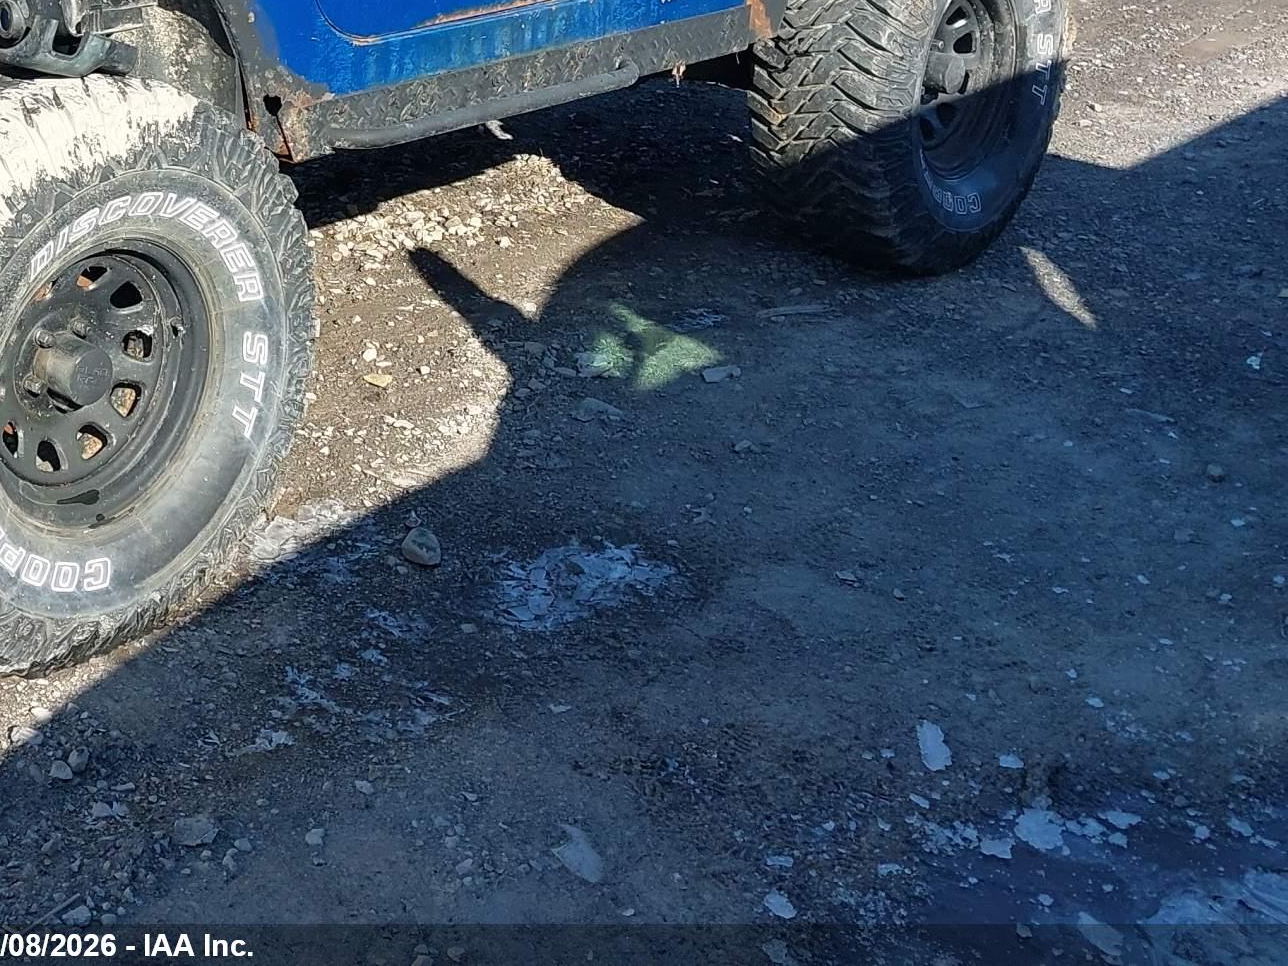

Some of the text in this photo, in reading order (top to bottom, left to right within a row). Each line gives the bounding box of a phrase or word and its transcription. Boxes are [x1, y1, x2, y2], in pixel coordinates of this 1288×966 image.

[1031, 33, 1054, 106] STT
[920, 148, 982, 215] COOP
[29, 191, 269, 439] DISCOVERER STT
